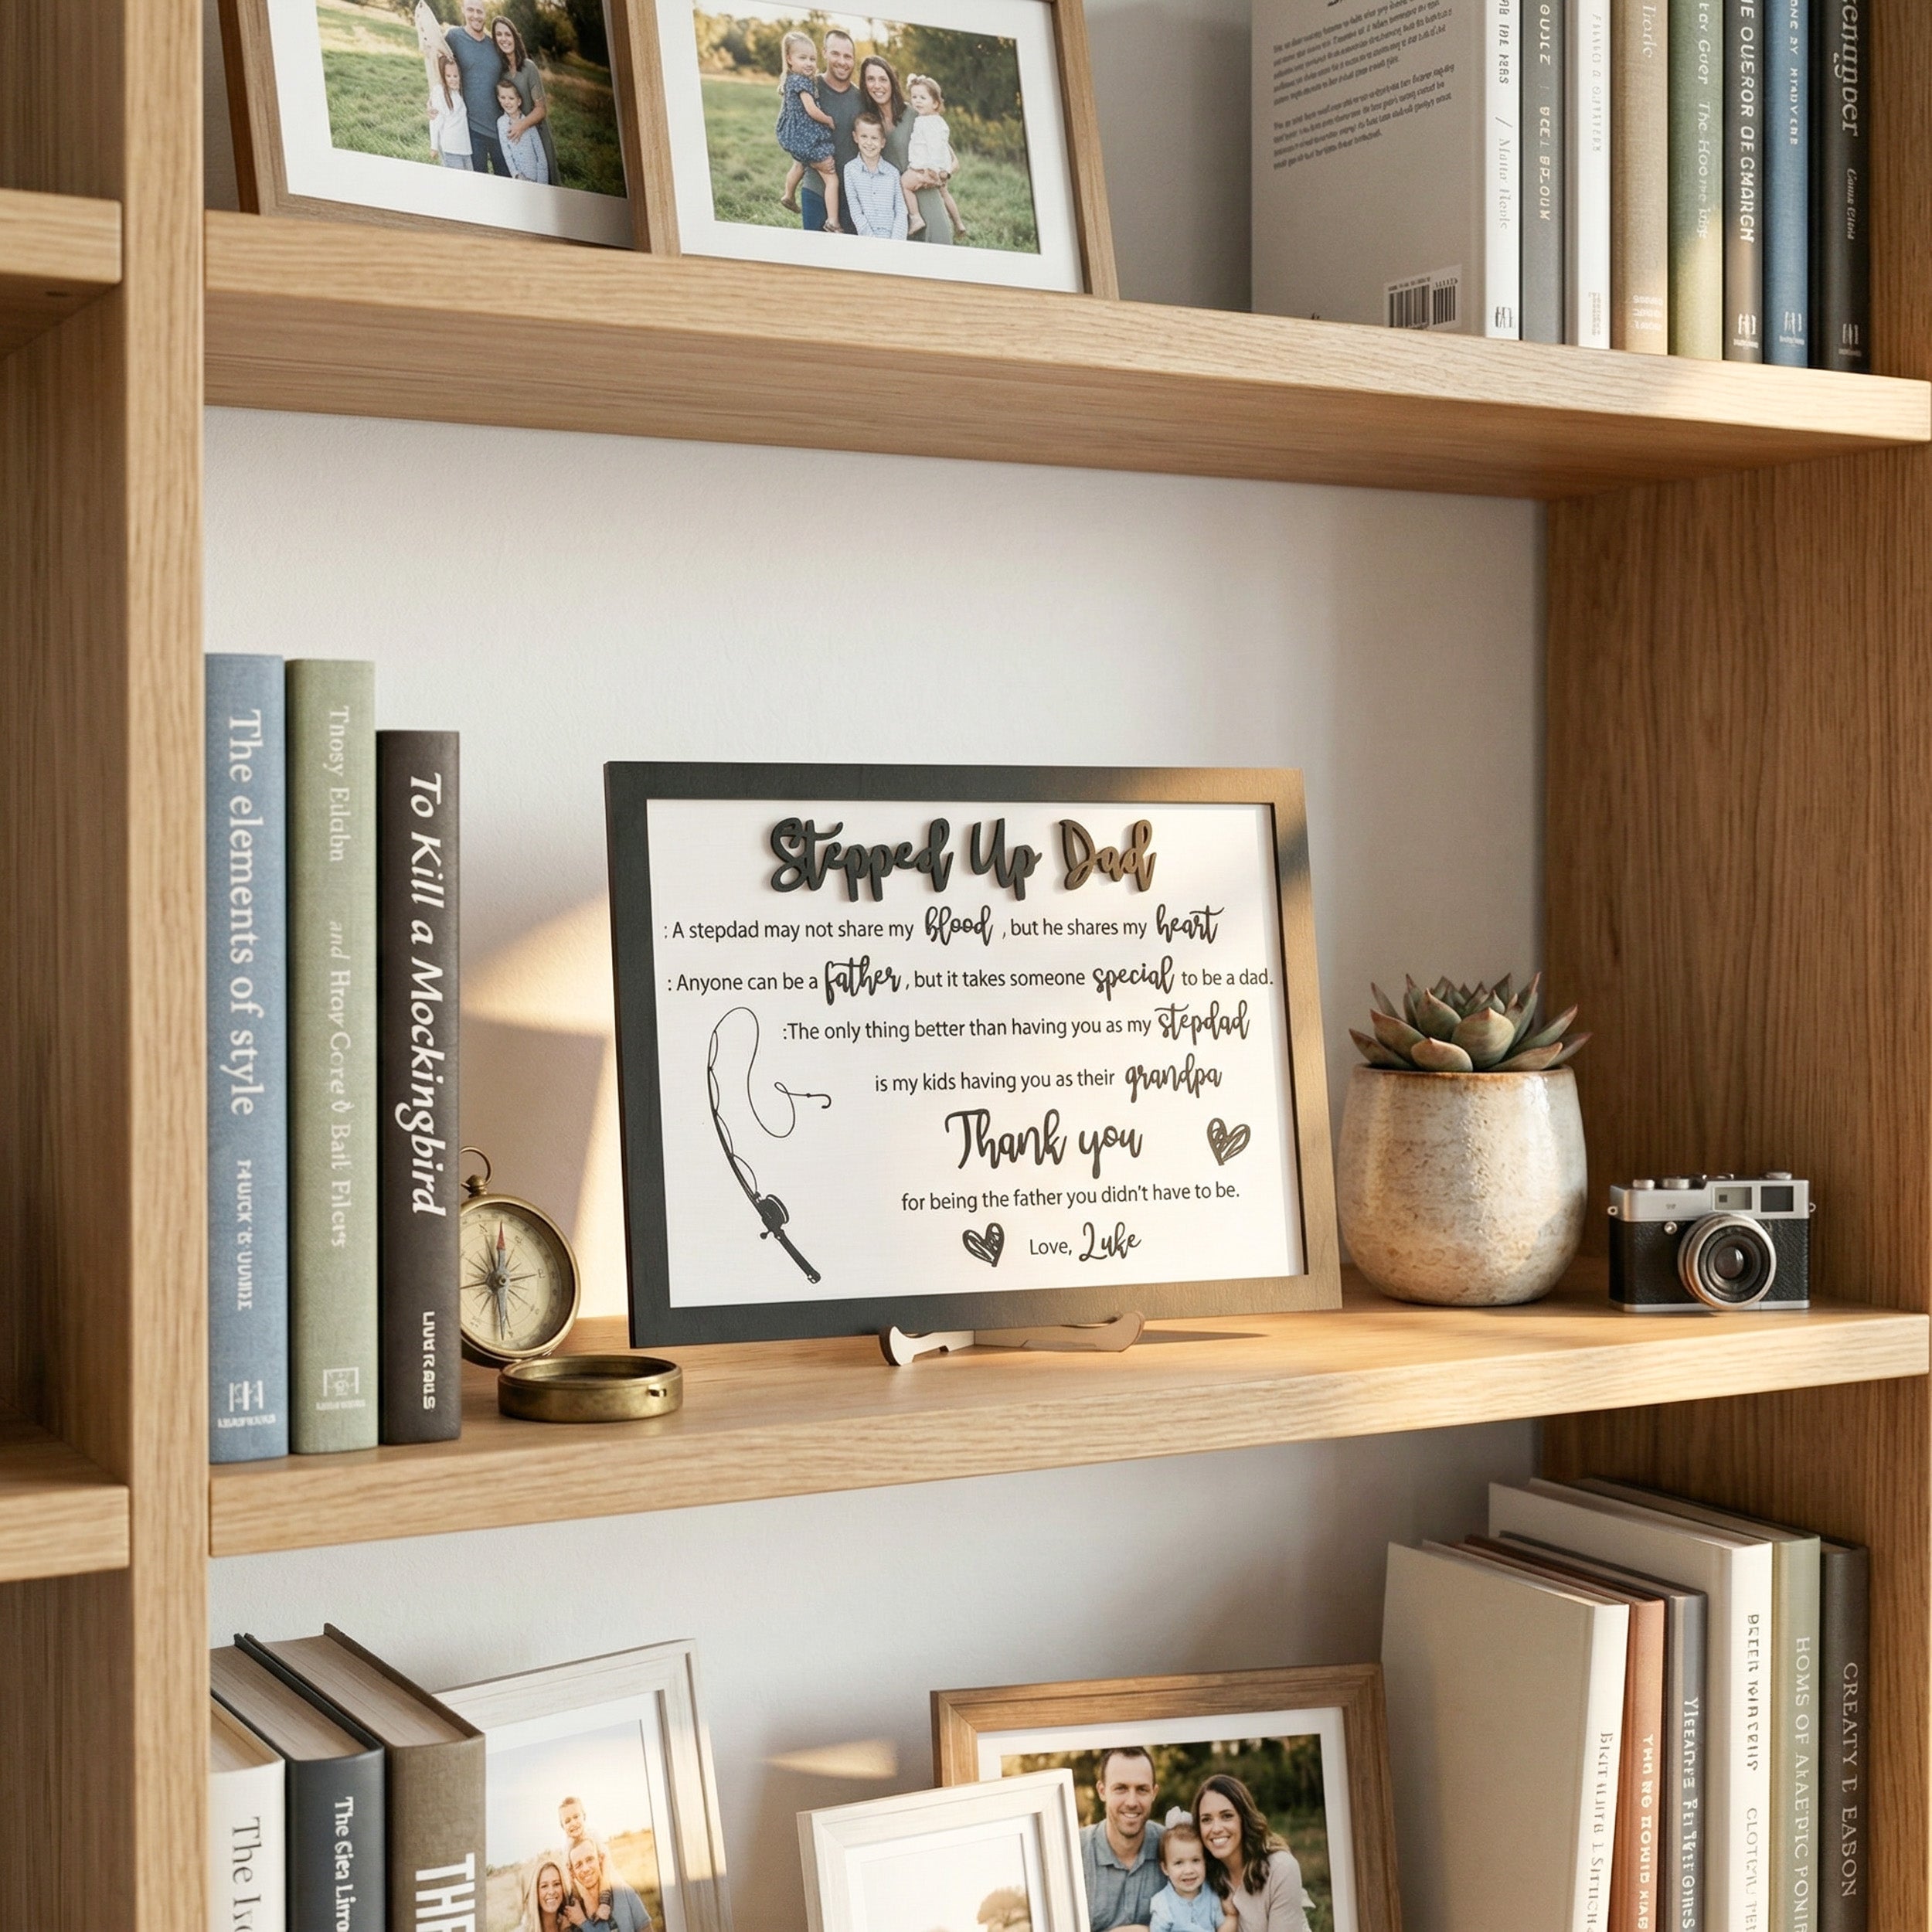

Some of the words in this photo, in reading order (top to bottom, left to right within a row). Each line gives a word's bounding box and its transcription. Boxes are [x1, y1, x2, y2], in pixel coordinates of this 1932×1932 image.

[230, 709, 264, 783] The
[410, 772, 442, 818] To
[229, 795, 264, 965] elements
[410, 831, 445, 909] Kill
[770, 818, 954, 902] Stepped
[970, 818, 1043, 901] Up
[1056, 818, 1157, 893] Dad
[329, 920, 352, 961] and
[410, 919, 434, 945] a
[672, 921, 685, 939] A
[689, 920, 759, 943] stepdad
[764, 924, 801, 943] may
[805, 921, 834, 937] not
[838, 919, 884, 937] share
[889, 923, 914, 942] my
[924, 904, 994, 947] blood
[1010, 918, 1039, 936] but
[1043, 917, 1063, 936] he
[1067, 917, 1119, 936] shares
[1123, 922, 1148, 940] my
[1156, 903, 1225, 944] heart
[230, 976, 264, 1019] of
[677, 973, 743, 996] Anyone
[747, 977, 777, 991] can
[782, 971, 804, 990] be
[808, 976, 818, 990] a
[825, 954, 902, 1006] father
[914, 970, 943, 988] but
[947, 970, 958, 988] it
[961, 969, 1006, 988] takes
[1009, 972, 1086, 987] someone
[1092, 955, 1175, 1002] special
[1181, 971, 1198, 986] to
[1202, 968, 1222, 985] be
[1226, 973, 1235, 985] a
[1239, 968, 1274, 985] dad.
[824, 1021, 861, 1044] only
[865, 1020, 910, 1043] thing
[914, 1019, 966, 1038] better
[968, 1018, 1007, 1036] than
[1012, 1018, 1067, 1039] having
[1071, 1021, 1101, 1039] you
[1106, 1020, 1123, 1033] as
[1128, 1019, 1151, 1037] my
[1154, 999, 1250, 1046] stepdad
[219, 1029, 265, 1116] style
[395, 956, 447, 1216] Mockingbird
[876, 1075, 888, 1092] is
[893, 1077, 919, 1096] my
[923, 1072, 957, 1090] kids
[961, 1071, 1016, 1094] having
[1020, 1075, 1051, 1093] you
[1056, 1073, 1073, 1087] as
[1077, 1068, 1115, 1087] their
[1124, 1053, 1223, 1104] grandpa
[944, 1108, 1067, 1170] Thank
[1078, 1125, 1143, 1179] you
[901, 1192, 926, 1211] for
[930, 1192, 978, 1213] being
[981, 1190, 1009, 1208] the
[1013, 1188, 1063, 1206] father
[1066, 1191, 1097, 1209] you
[1101, 1185, 1148, 1203] didn't
[1153, 1183, 1191, 1201] have
[1194, 1184, 1212, 1199] to
[1216, 1181, 1240, 1198] be.
[1029, 1239, 1072, 1256] Love,
[1078, 1221, 1141, 1262] Luke
[1795, 1714, 1810, 1745] OF
[335, 1796, 354, 1837] The
[233, 1817, 262, 1884] The
